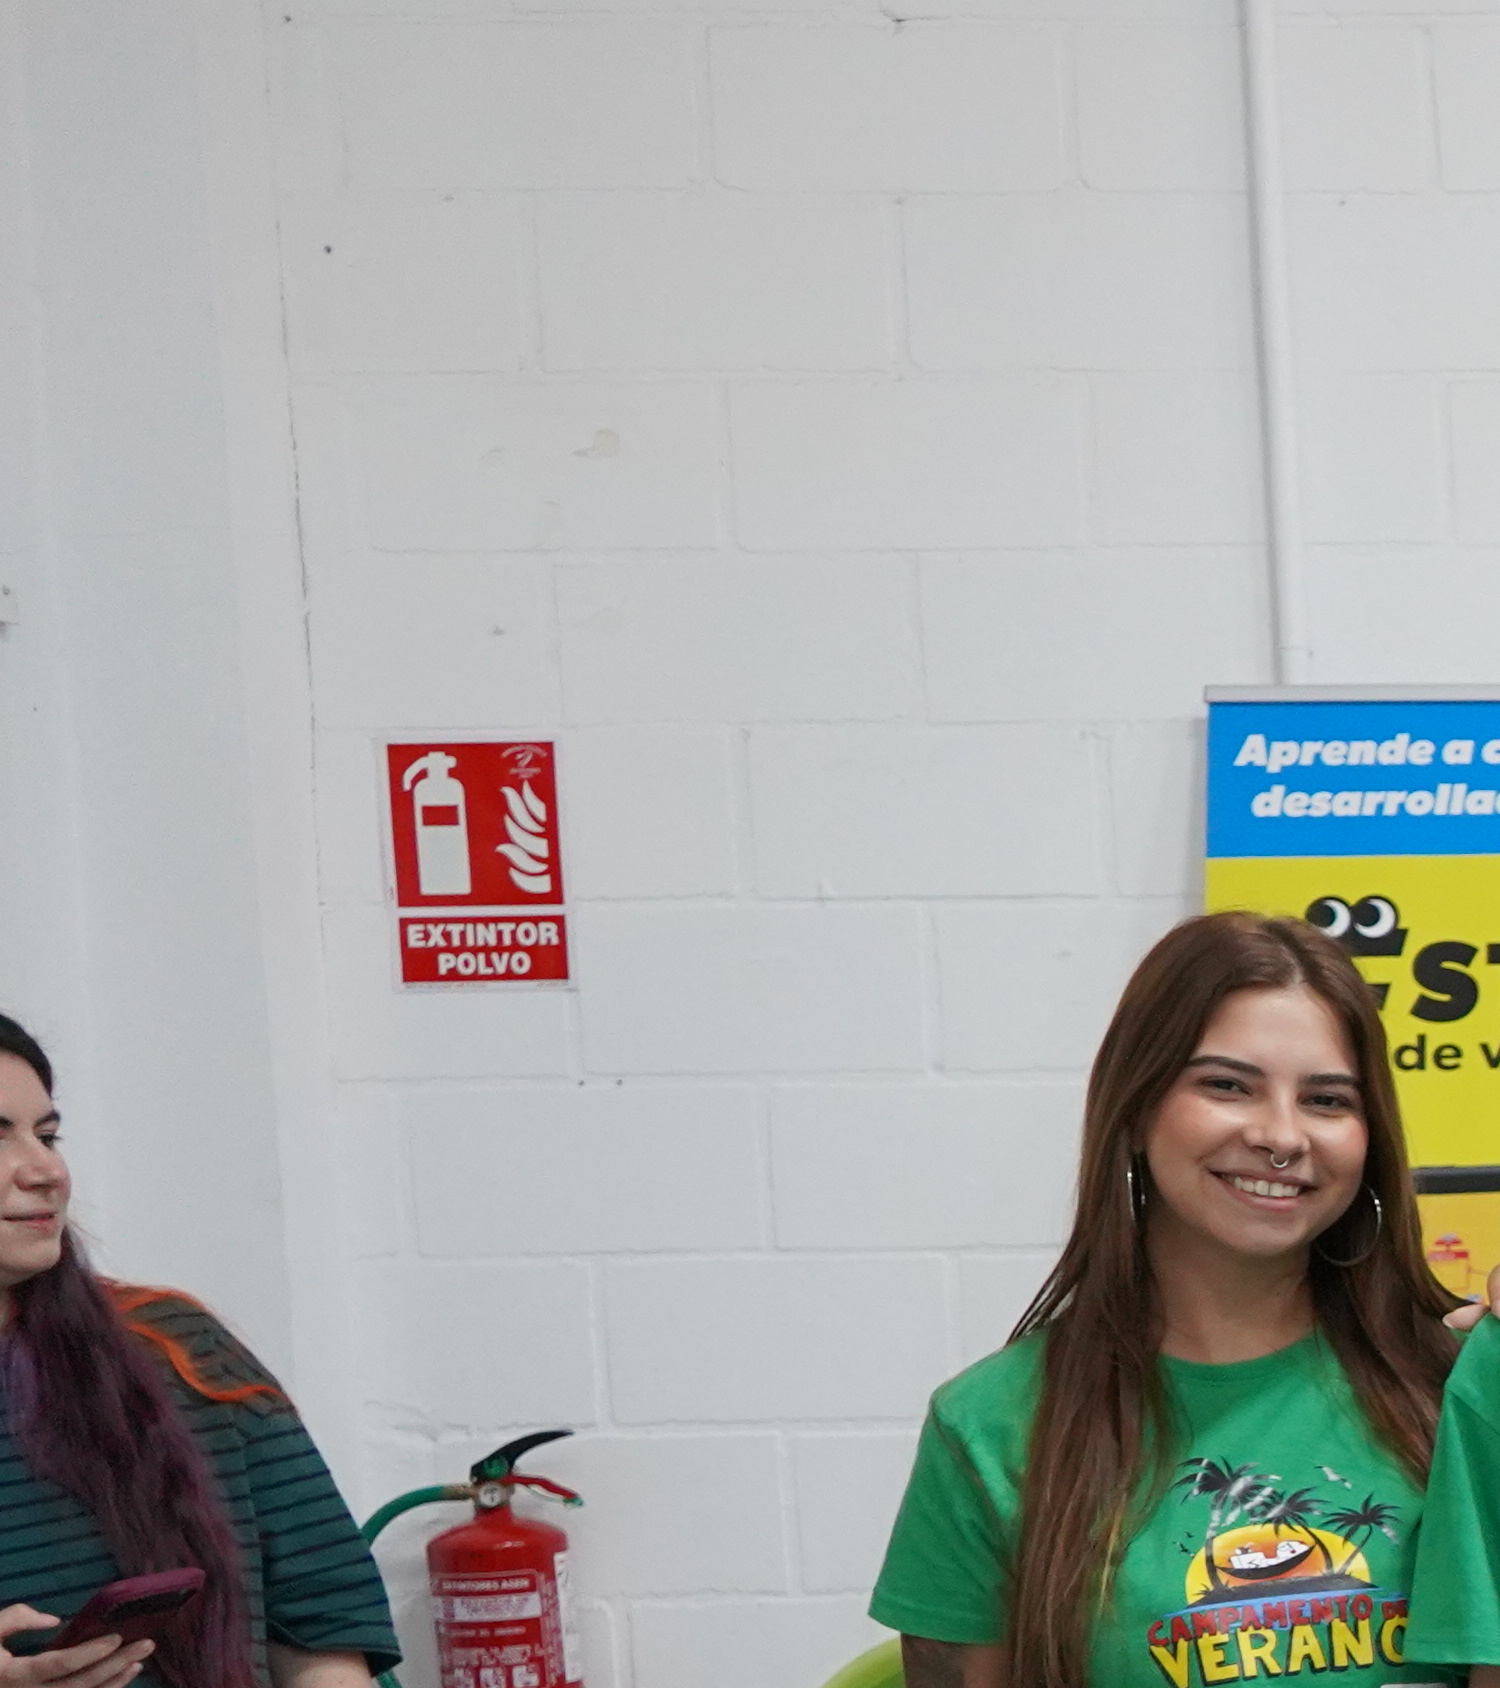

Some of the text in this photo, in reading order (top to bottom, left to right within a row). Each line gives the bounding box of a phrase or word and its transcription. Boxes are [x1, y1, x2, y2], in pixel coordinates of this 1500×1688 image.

[1232, 732, 1436, 773] Aprende
[1441, 738, 1475, 765] a
[406, 922, 560, 948] EXTINTOR
[437, 951, 532, 976] POLVO
[1393, 1033, 1463, 1071] de
[1147, 1594, 1374, 1647] CAMPAMENTO
